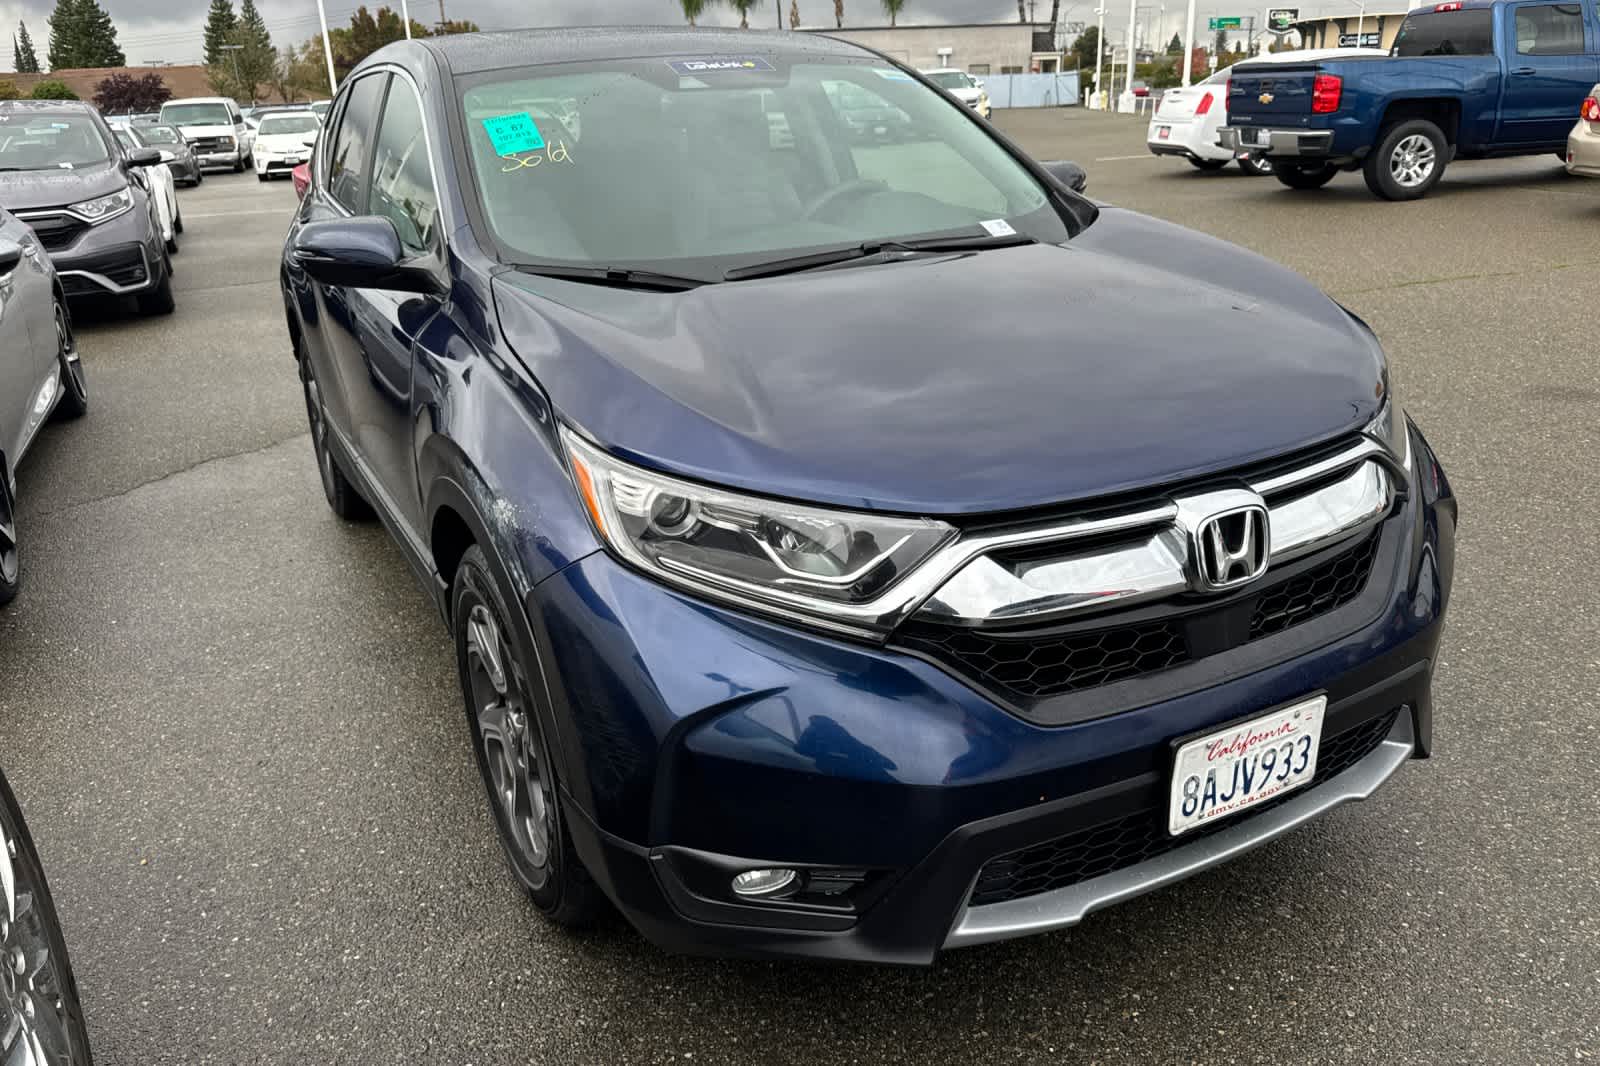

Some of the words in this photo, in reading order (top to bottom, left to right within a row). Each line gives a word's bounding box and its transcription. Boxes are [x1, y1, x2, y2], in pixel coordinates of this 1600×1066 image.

[501, 139, 576, 172] Sold
[1207, 720, 1297, 761] California
[1181, 734, 1312, 817] 8AJV933
